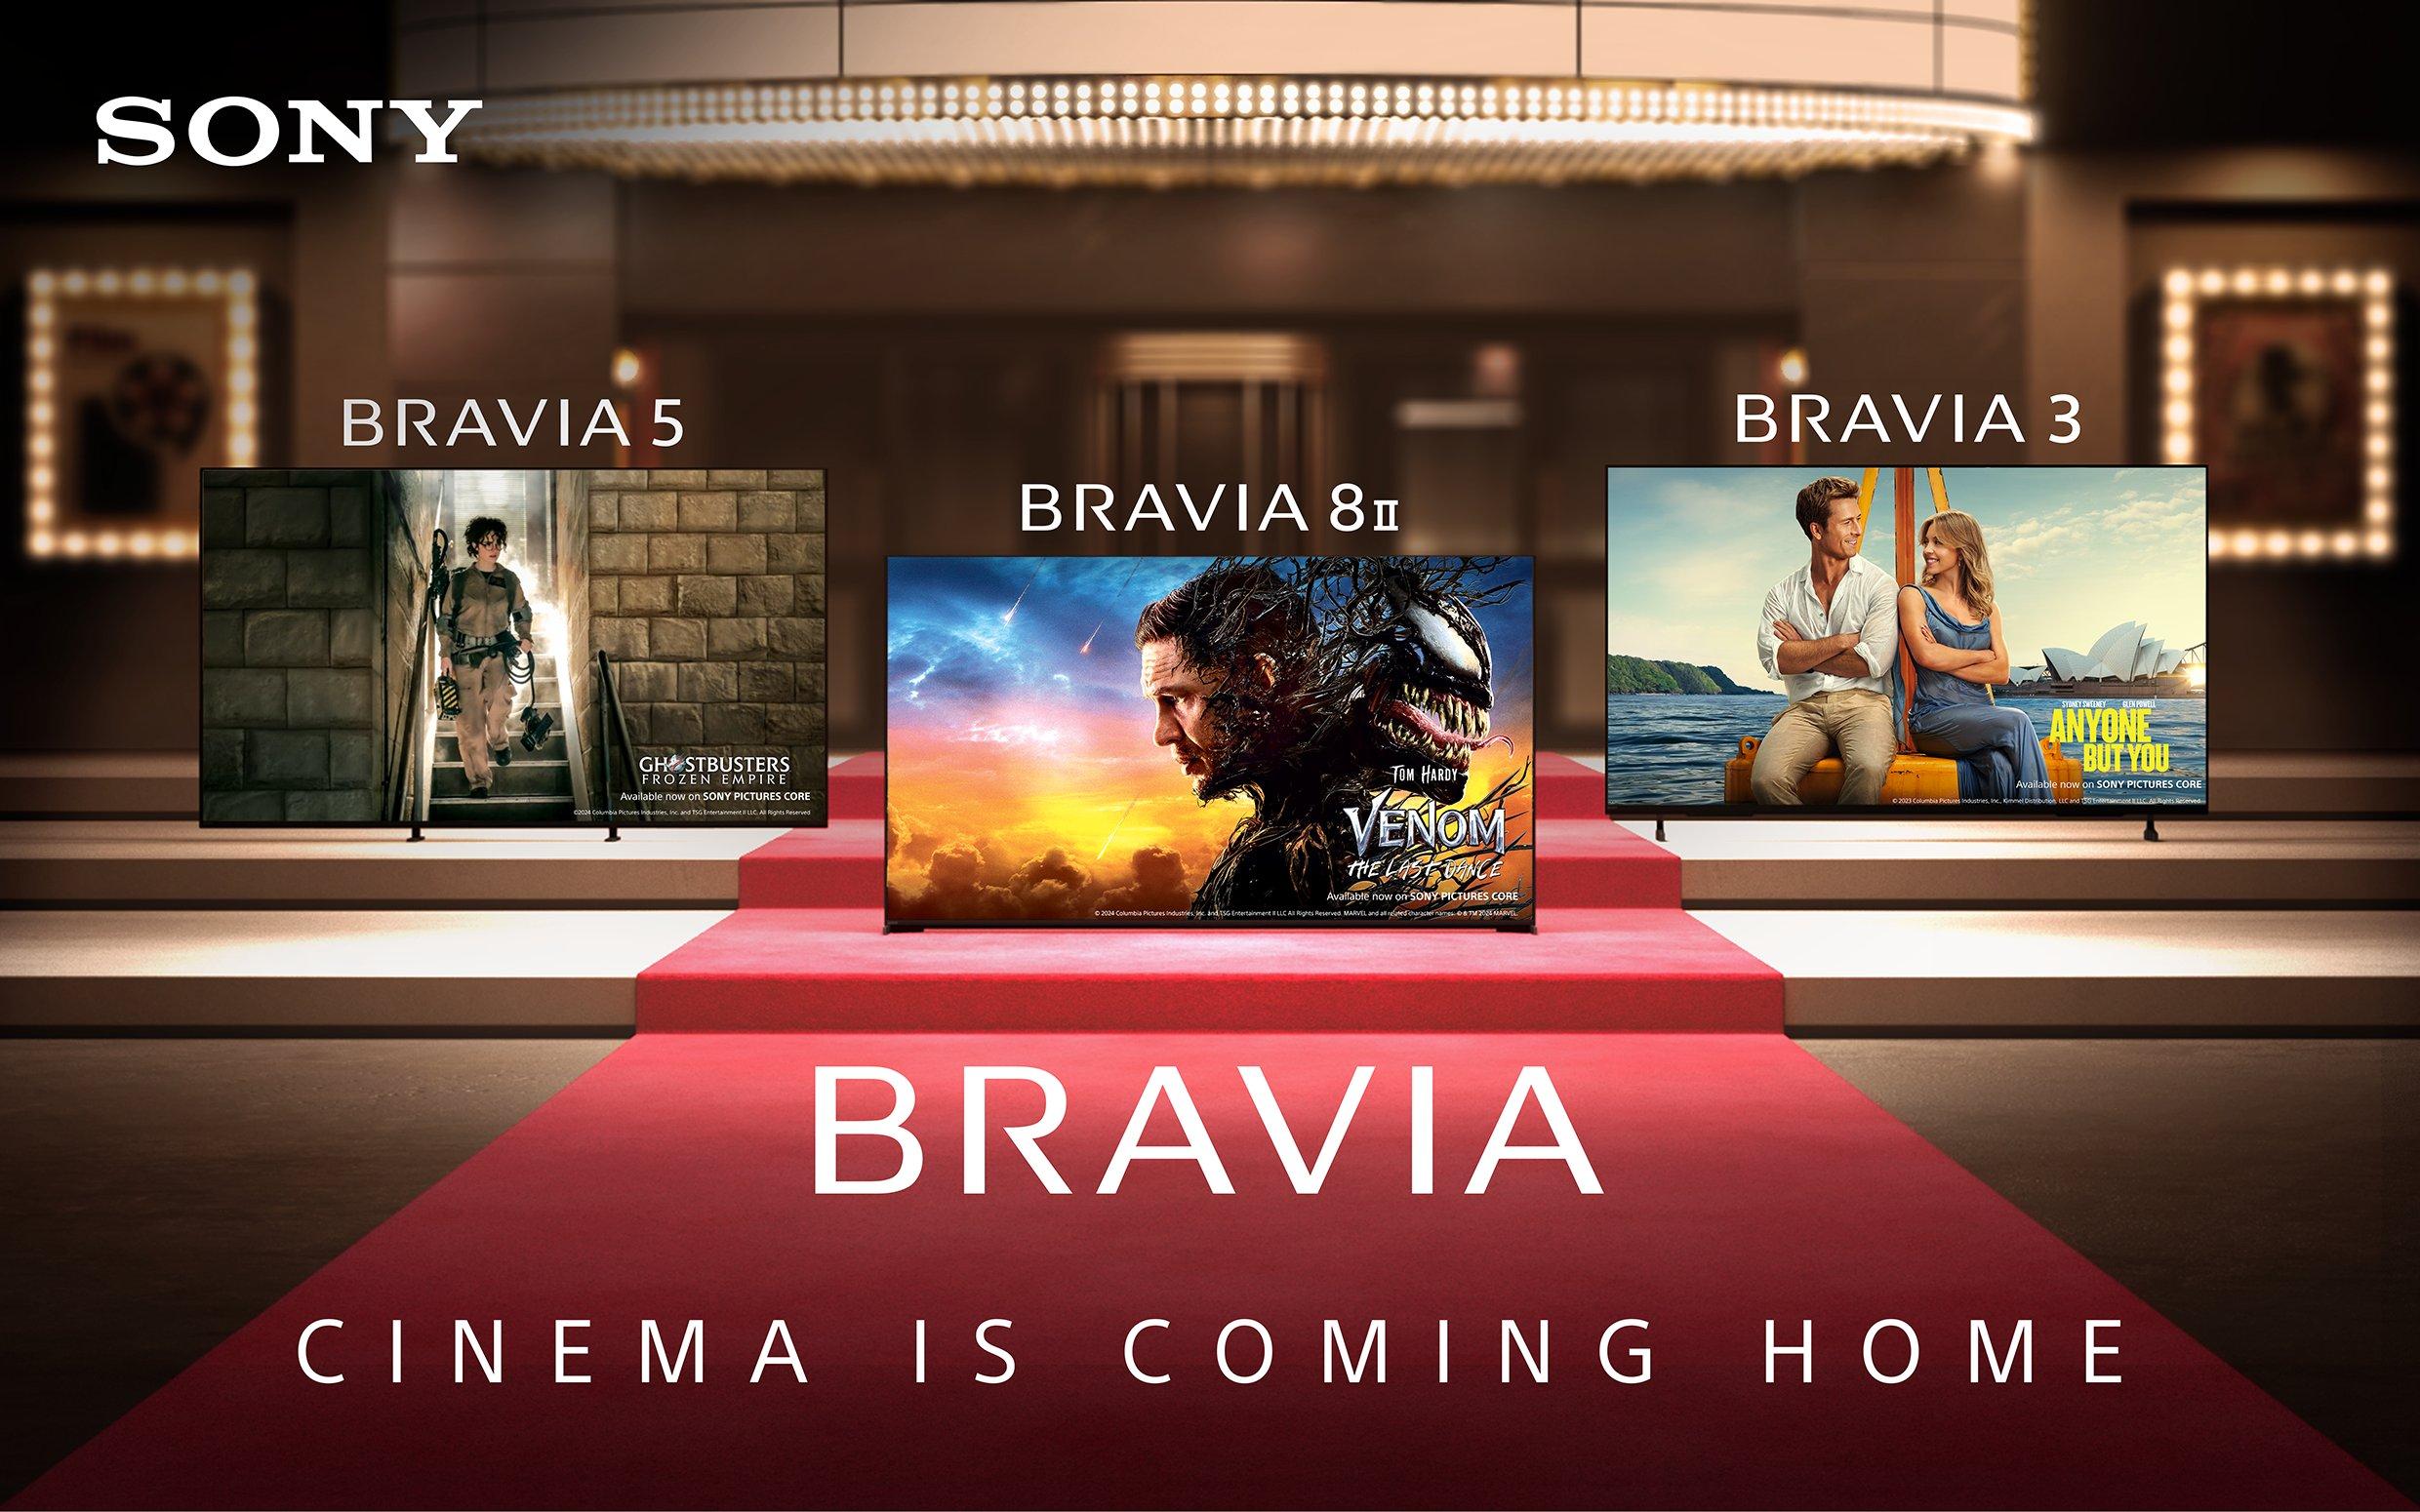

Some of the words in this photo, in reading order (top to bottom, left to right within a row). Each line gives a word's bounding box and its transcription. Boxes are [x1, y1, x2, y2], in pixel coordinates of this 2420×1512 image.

[2049, 708, 2152, 743] ANYONE
[2083, 743, 2124, 773] BUT
[2126, 743, 2169, 773] YOU
[642, 774, 710, 785] FROZEN
[722, 774, 787, 785] EMPIRE
[2016, 780, 2059, 789] Available
[2097, 780, 2123, 789] SONY
[2127, 780, 2173, 789] PICTURES
[2176, 780, 2202, 789] CORE
[621, 791, 664, 801] Available
[703, 791, 732, 801] SONY
[734, 791, 782, 801] PICTURES
[785, 791, 811, 801] CORE
[1343, 787, 1506, 857] VENOM
[1326, 892, 1369, 901] Available
[1410, 892, 1440, 901] SONY
[1441, 892, 1489, 901] PICTURES
[1492, 892, 1519, 901] CORE
